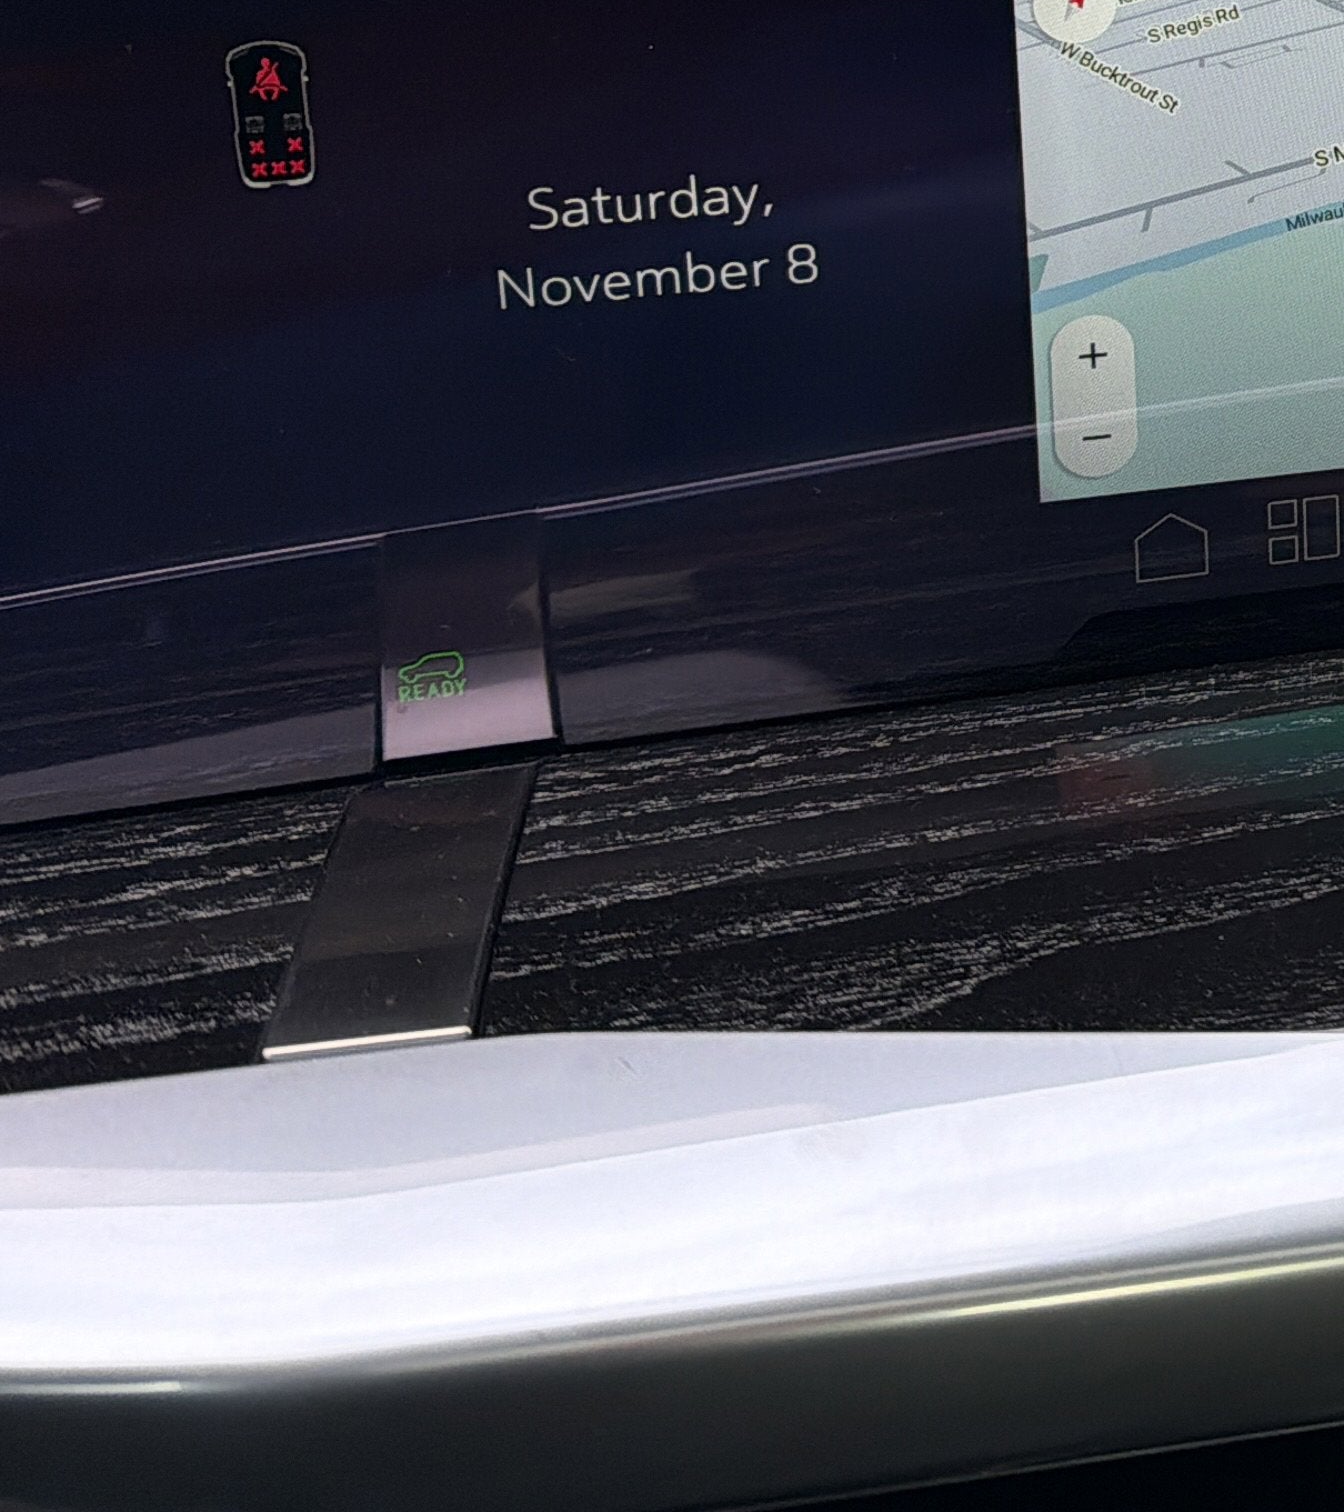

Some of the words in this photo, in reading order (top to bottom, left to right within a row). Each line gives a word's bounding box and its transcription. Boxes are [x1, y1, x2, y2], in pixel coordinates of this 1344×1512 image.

[1147, 28, 1160, 43] S
[1163, 14, 1214, 39] Regis
[1216, 5, 1241, 22] Rd
[1060, 41, 1081, 60] W
[1080, 50, 1159, 105] Bucktrout
[1159, 93, 1179, 113] St
[1313, 149, 1329, 167] S
[529, 174, 774, 230] Saturday,
[497, 251, 770, 310] November
[787, 243, 819, 285] 8
[398, 678, 467, 703] READY
